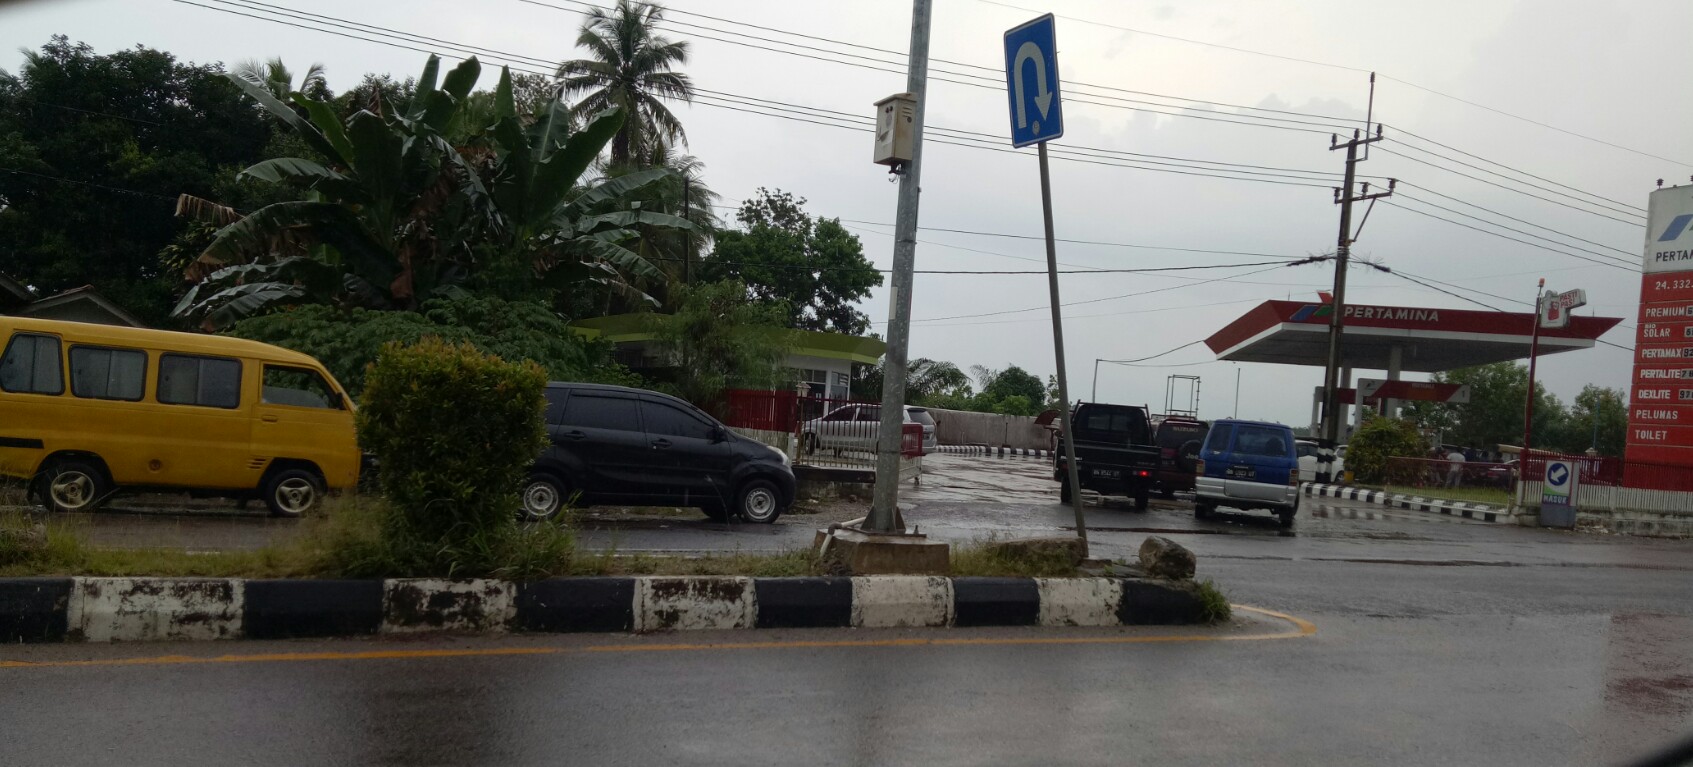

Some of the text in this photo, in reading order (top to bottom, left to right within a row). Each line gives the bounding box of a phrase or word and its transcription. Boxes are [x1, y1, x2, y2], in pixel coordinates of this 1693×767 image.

[1344, 306, 1439, 321] PERTAMINA
[1645, 307, 1685, 318] PREMIUM
[1643, 328, 1670, 338] SOLAR
[1641, 348, 1682, 358] PERTAMAX
[1640, 369, 1681, 379] PERTALITE
[1638, 389, 1671, 399] DEXLITE
[1635, 409, 1679, 420] PELUMAS
[1635, 430, 1668, 440] TOILET
[1543, 495, 1567, 504] MASUK
